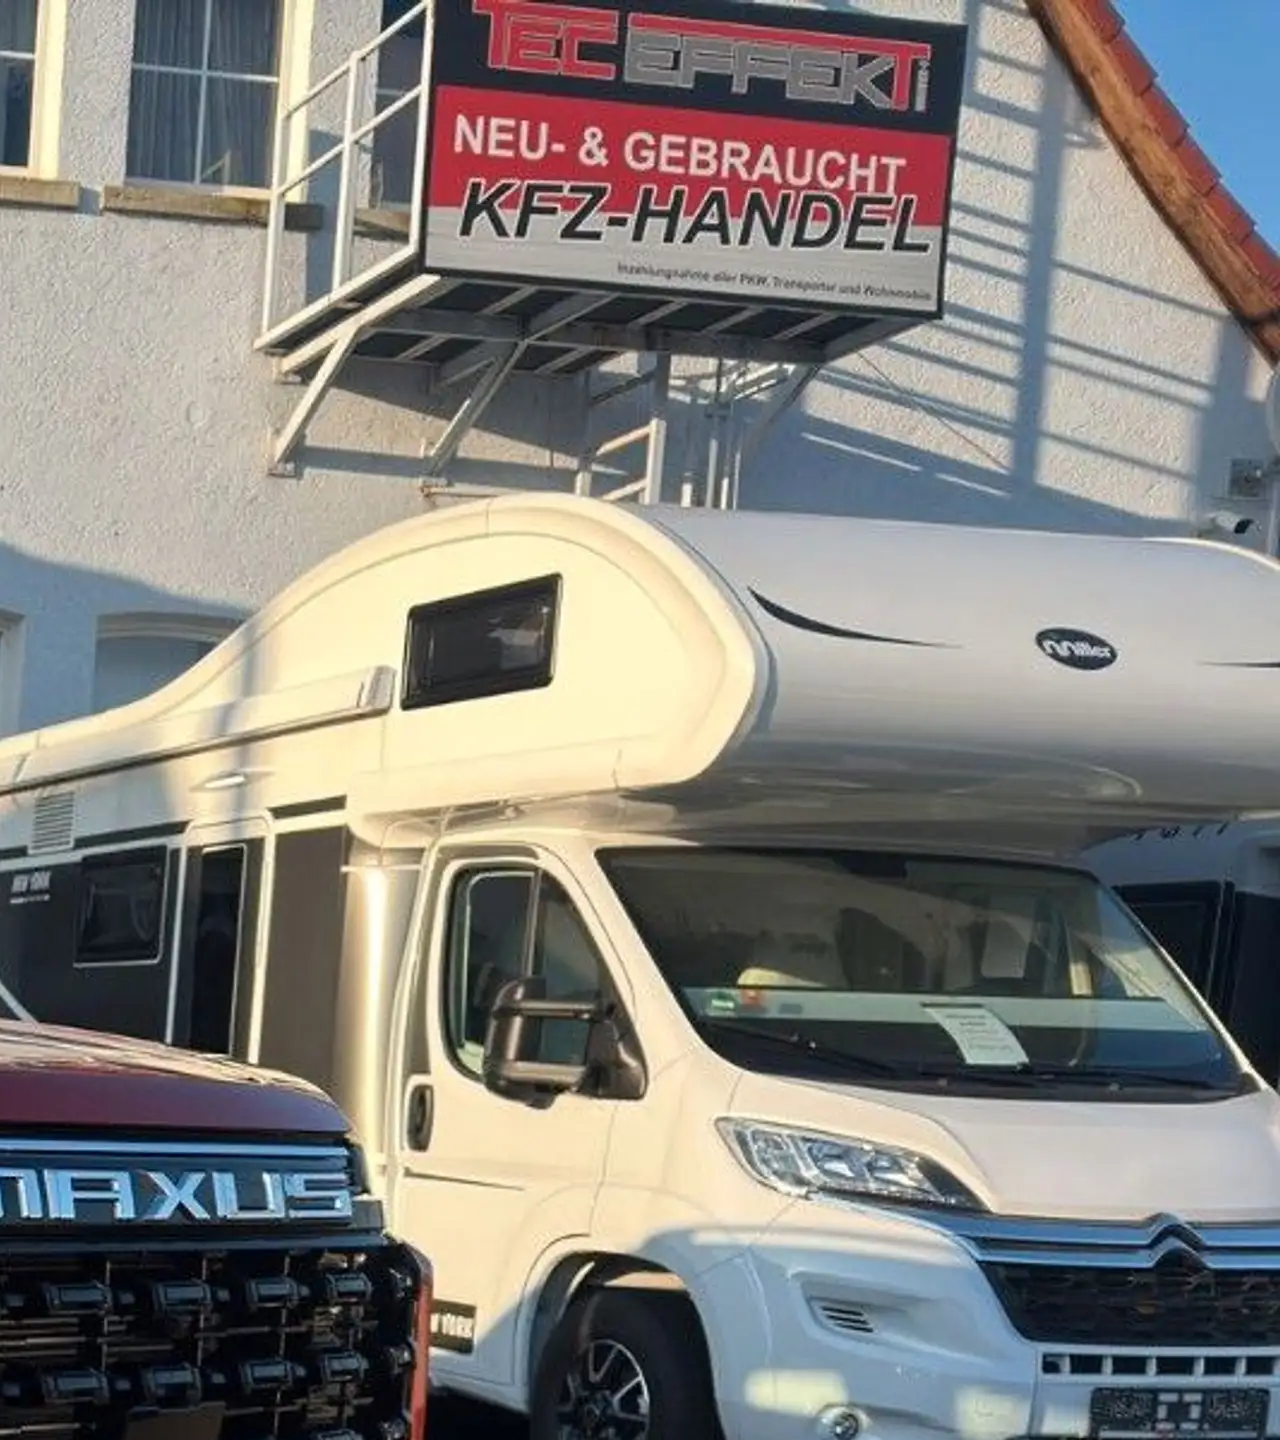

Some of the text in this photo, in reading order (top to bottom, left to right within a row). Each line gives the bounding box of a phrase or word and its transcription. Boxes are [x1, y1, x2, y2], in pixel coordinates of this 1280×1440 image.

[472, 0, 620, 80] TEC
[624, 12, 931, 112] EFFEKT
[454, 114, 907, 194] NEU- & GEBRAUCHT
[457, 178, 932, 255] KFZ-HANDEL
